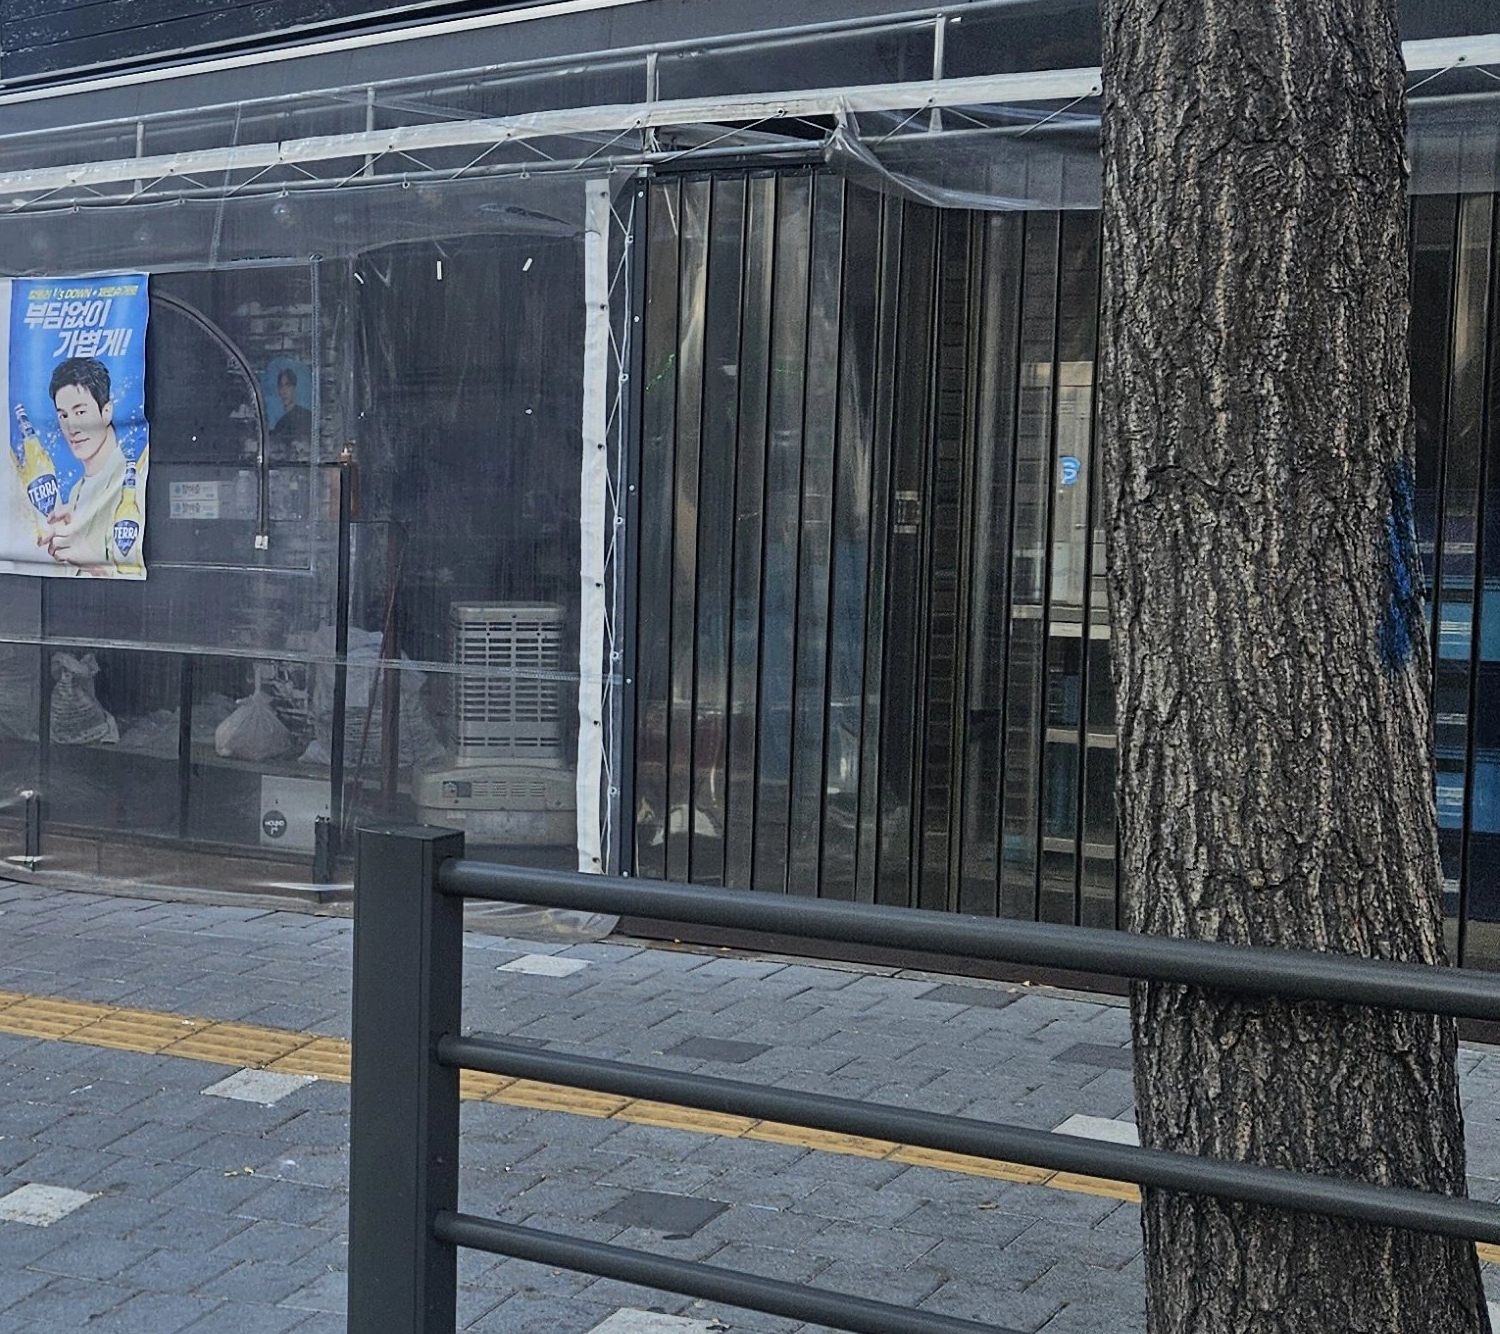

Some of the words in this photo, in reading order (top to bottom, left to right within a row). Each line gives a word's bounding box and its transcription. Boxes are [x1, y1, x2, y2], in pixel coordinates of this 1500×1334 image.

[23, 299, 112, 329] 부담없이
[53, 328, 132, 358] 가볍게!
[28, 479, 59, 504] TERRA
[114, 527, 138, 540] TERRA
